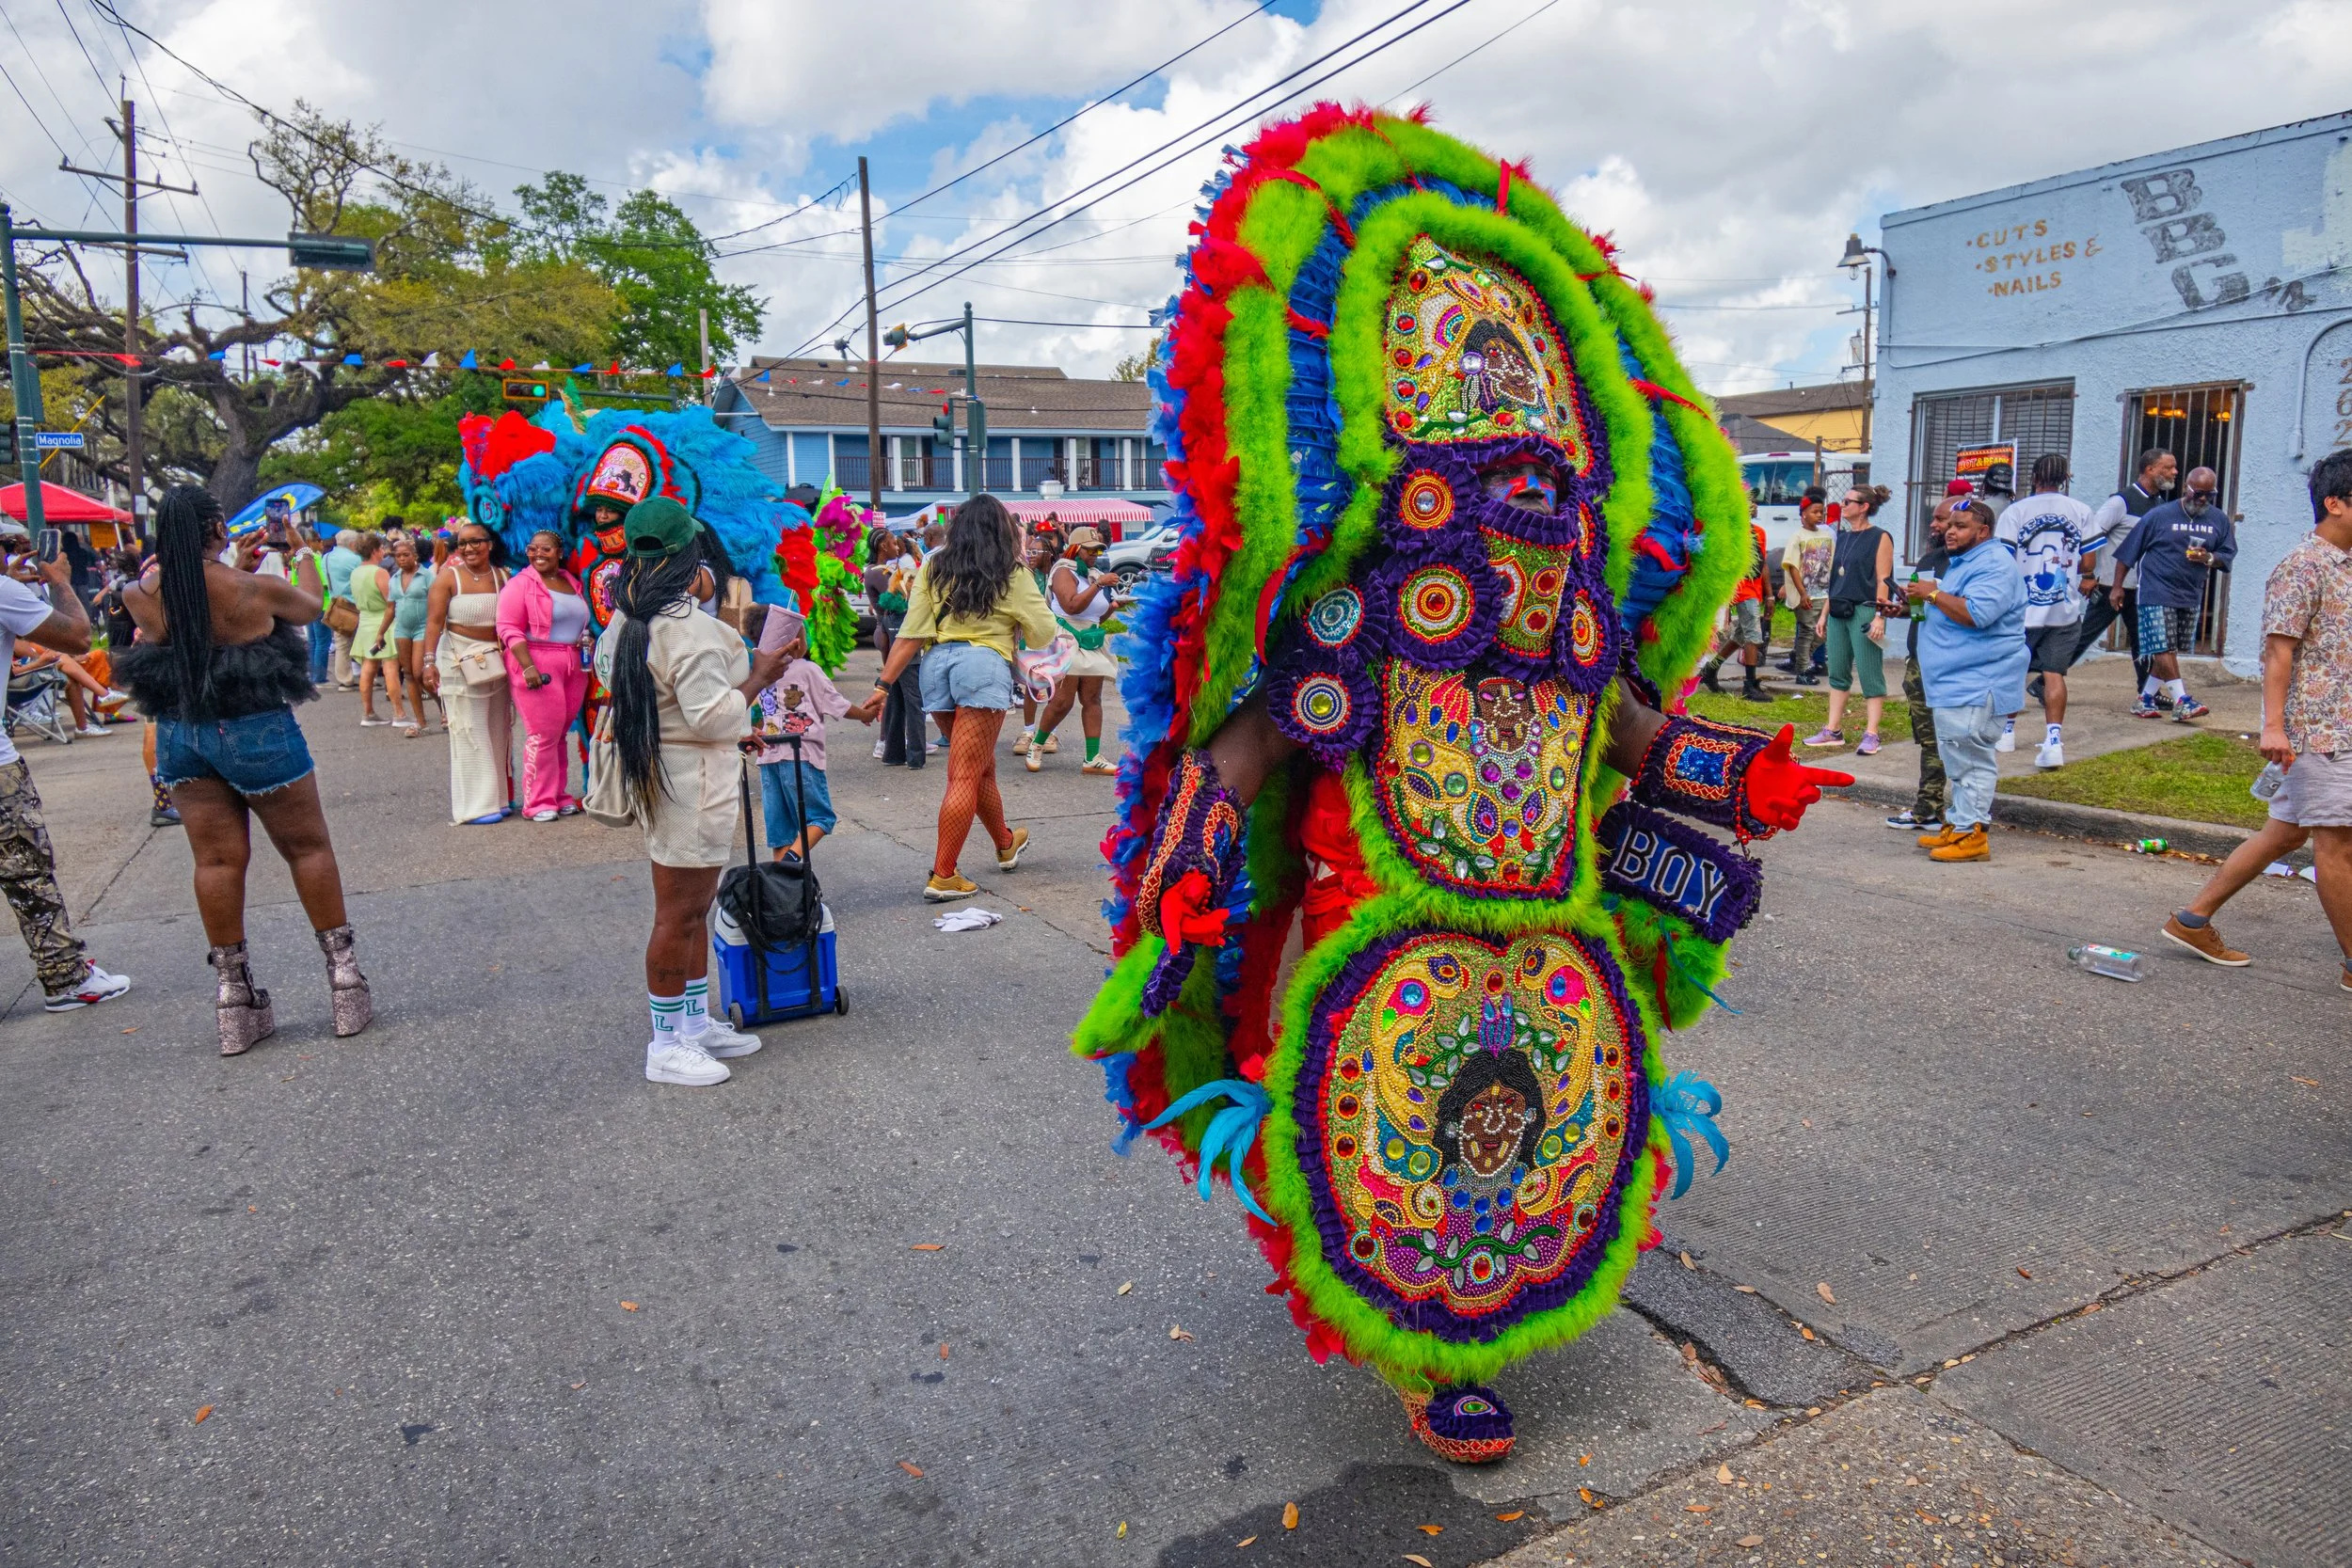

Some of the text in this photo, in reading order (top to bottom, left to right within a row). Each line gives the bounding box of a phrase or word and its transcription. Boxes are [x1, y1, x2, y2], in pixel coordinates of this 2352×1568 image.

[1977, 218, 2048, 247] CUTS
[1984, 233, 2103, 273] STYLES &
[1994, 271, 2061, 297] NAILS
[39, 435, 82, 447] Magnolia
[2172, 523, 2214, 533] EMLINE
[1611, 825, 1729, 922] BOY
[686, 999, 705, 1016] L
[655, 1015, 674, 1032] L
